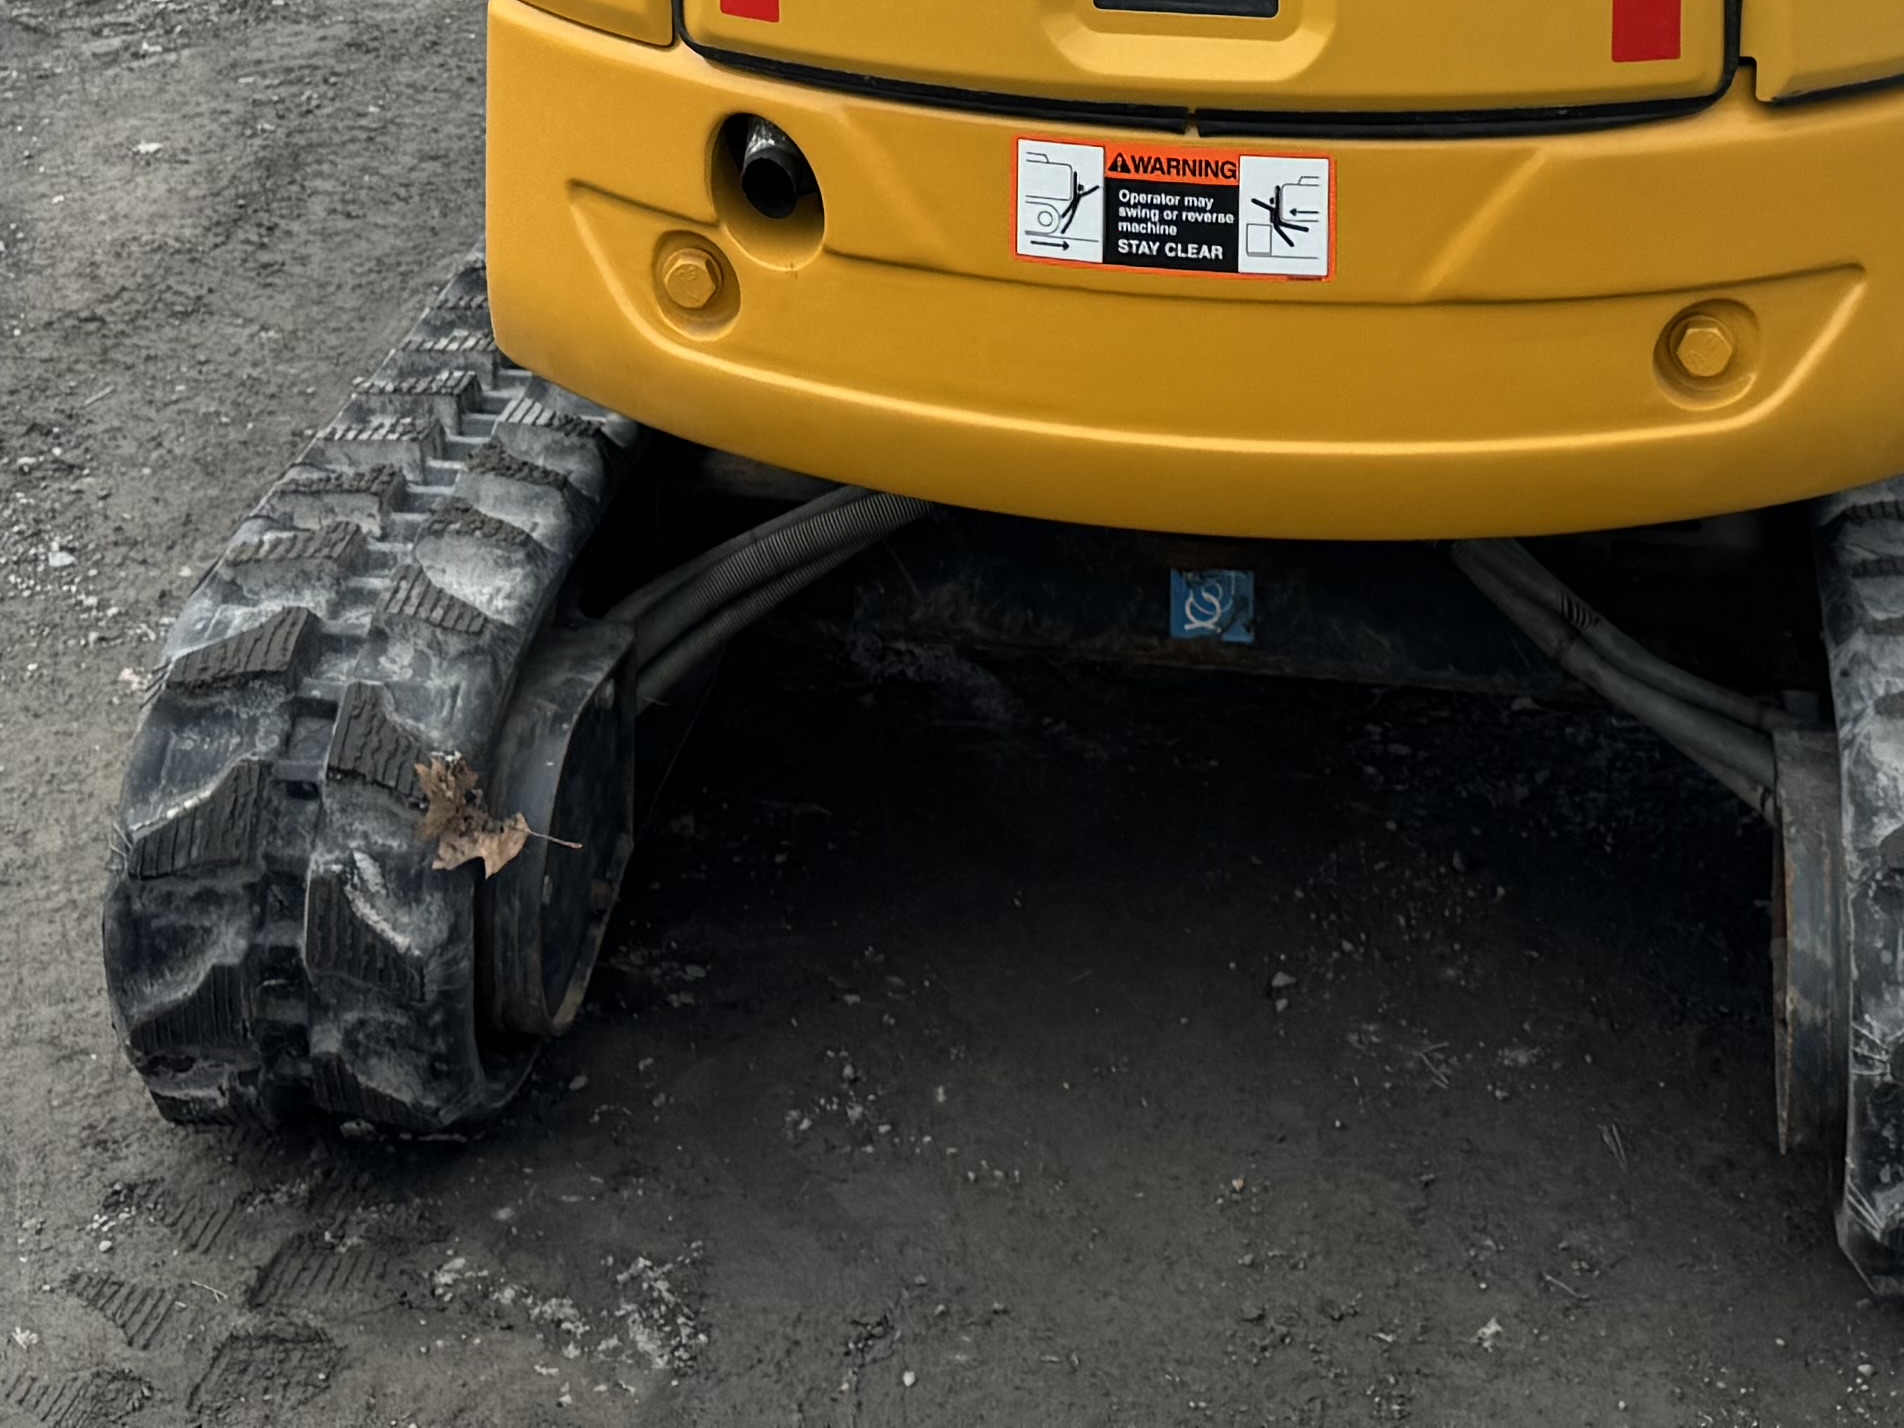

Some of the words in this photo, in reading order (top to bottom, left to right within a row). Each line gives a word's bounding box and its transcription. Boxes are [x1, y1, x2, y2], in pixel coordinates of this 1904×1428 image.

[1130, 155, 1237, 180] WARNING
[1118, 189, 1180, 205] Operator
[1184, 195, 1214, 211] may
[1118, 206, 1159, 222] swing
[1163, 210, 1178, 221] or
[1182, 211, 1235, 224] reverse
[1118, 221, 1178, 236] machine
[1117, 238, 1160, 256] STAY
[1164, 242, 1224, 260] CLEAR
